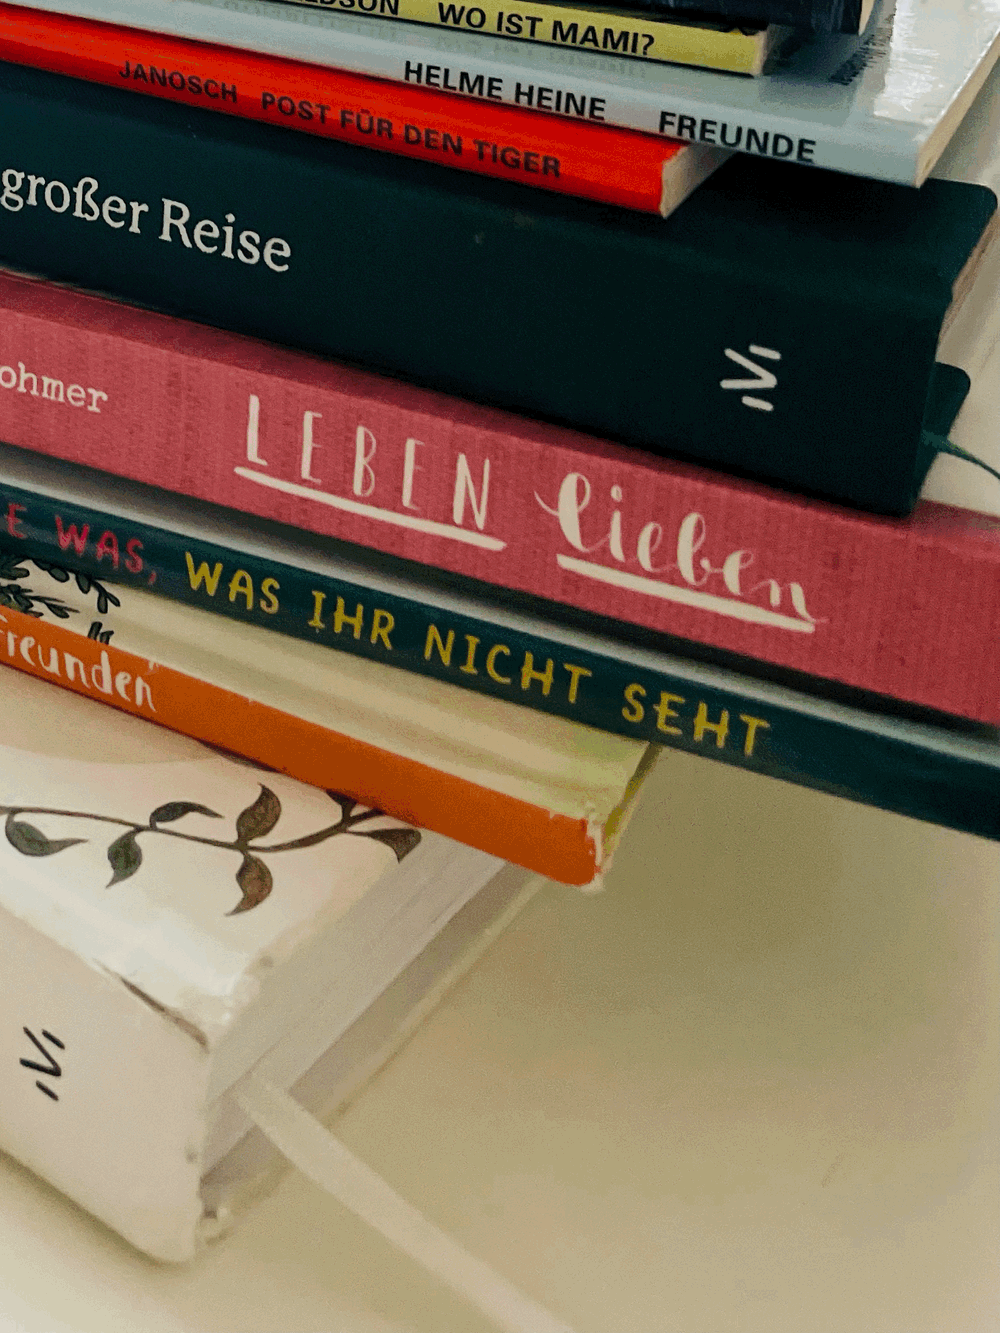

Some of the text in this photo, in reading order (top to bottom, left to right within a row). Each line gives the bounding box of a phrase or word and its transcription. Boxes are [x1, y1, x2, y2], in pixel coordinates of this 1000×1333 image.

[437, 2, 487, 30] WO
[497, 9, 543, 39] IST
[552, 17, 655, 57] MAMI?
[118, 61, 562, 179] JANOSCH POST FÜR DEN TIGER
[405, 61, 816, 164] HELME HEINE FREUNDE
[1, 165, 148, 236] großer
[159, 200, 292, 273] Reise
[246, 394, 491, 530] LEBEN
[55, 515, 156, 584] WAS,
[186, 550, 281, 615] WAS
[308, 590, 396, 651] IHR
[424, 624, 592, 704] NICHT
[622, 684, 772, 757] SEHT
